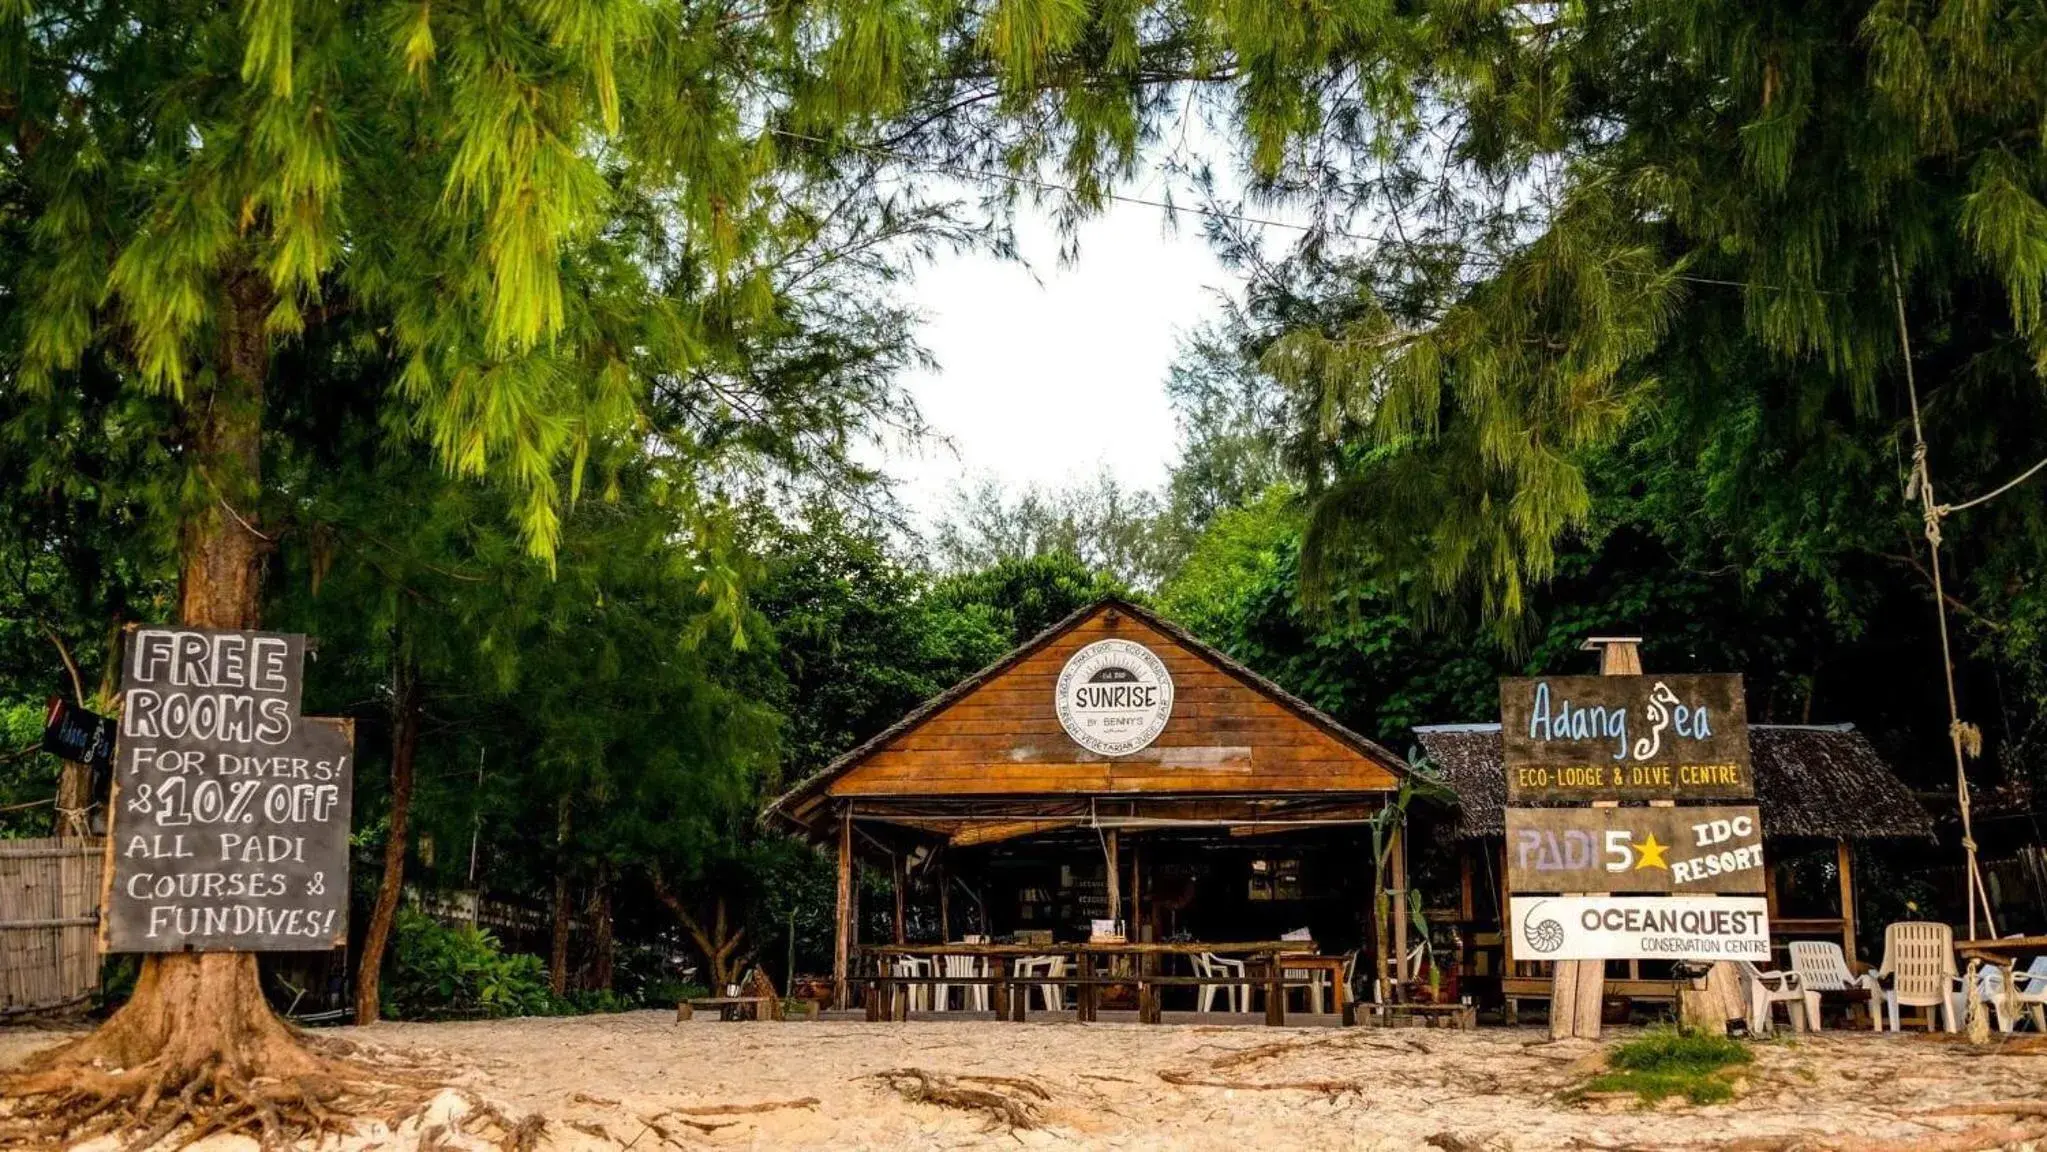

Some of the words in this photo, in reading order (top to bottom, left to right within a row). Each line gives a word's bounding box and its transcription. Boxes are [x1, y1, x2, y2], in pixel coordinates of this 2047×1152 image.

[134, 630, 288, 692] FREE
[1075, 686, 1157, 708] SUNRISE
[124, 688, 291, 745] ROOMS
[1530, 682, 1627, 760] Adang
[1633, 681, 1712, 760] Sea
[131, 747, 205, 775] FOR
[218, 754, 346, 780] DIVERS!
[1519, 767, 1604, 786] ECO-LODGE
[1613, 768, 1624, 785] &
[1633, 766, 1671, 785] DIVE
[1680, 765, 1739, 785] CENTRE
[264, 783, 339, 823] OFF
[1692, 815, 1753, 847] IDC
[124, 835, 194, 859] ALL
[219, 833, 305, 863] PADI
[1518, 828, 1598, 871] PADI
[1605, 831, 1633, 872] 5
[1671, 844, 1763, 884] RESORT
[127, 873, 287, 900] COURSES
[306, 872, 325, 896] &
[1641, 937, 1720, 953] CONSERVATION
[1725, 939, 1769, 954] CENTRE
